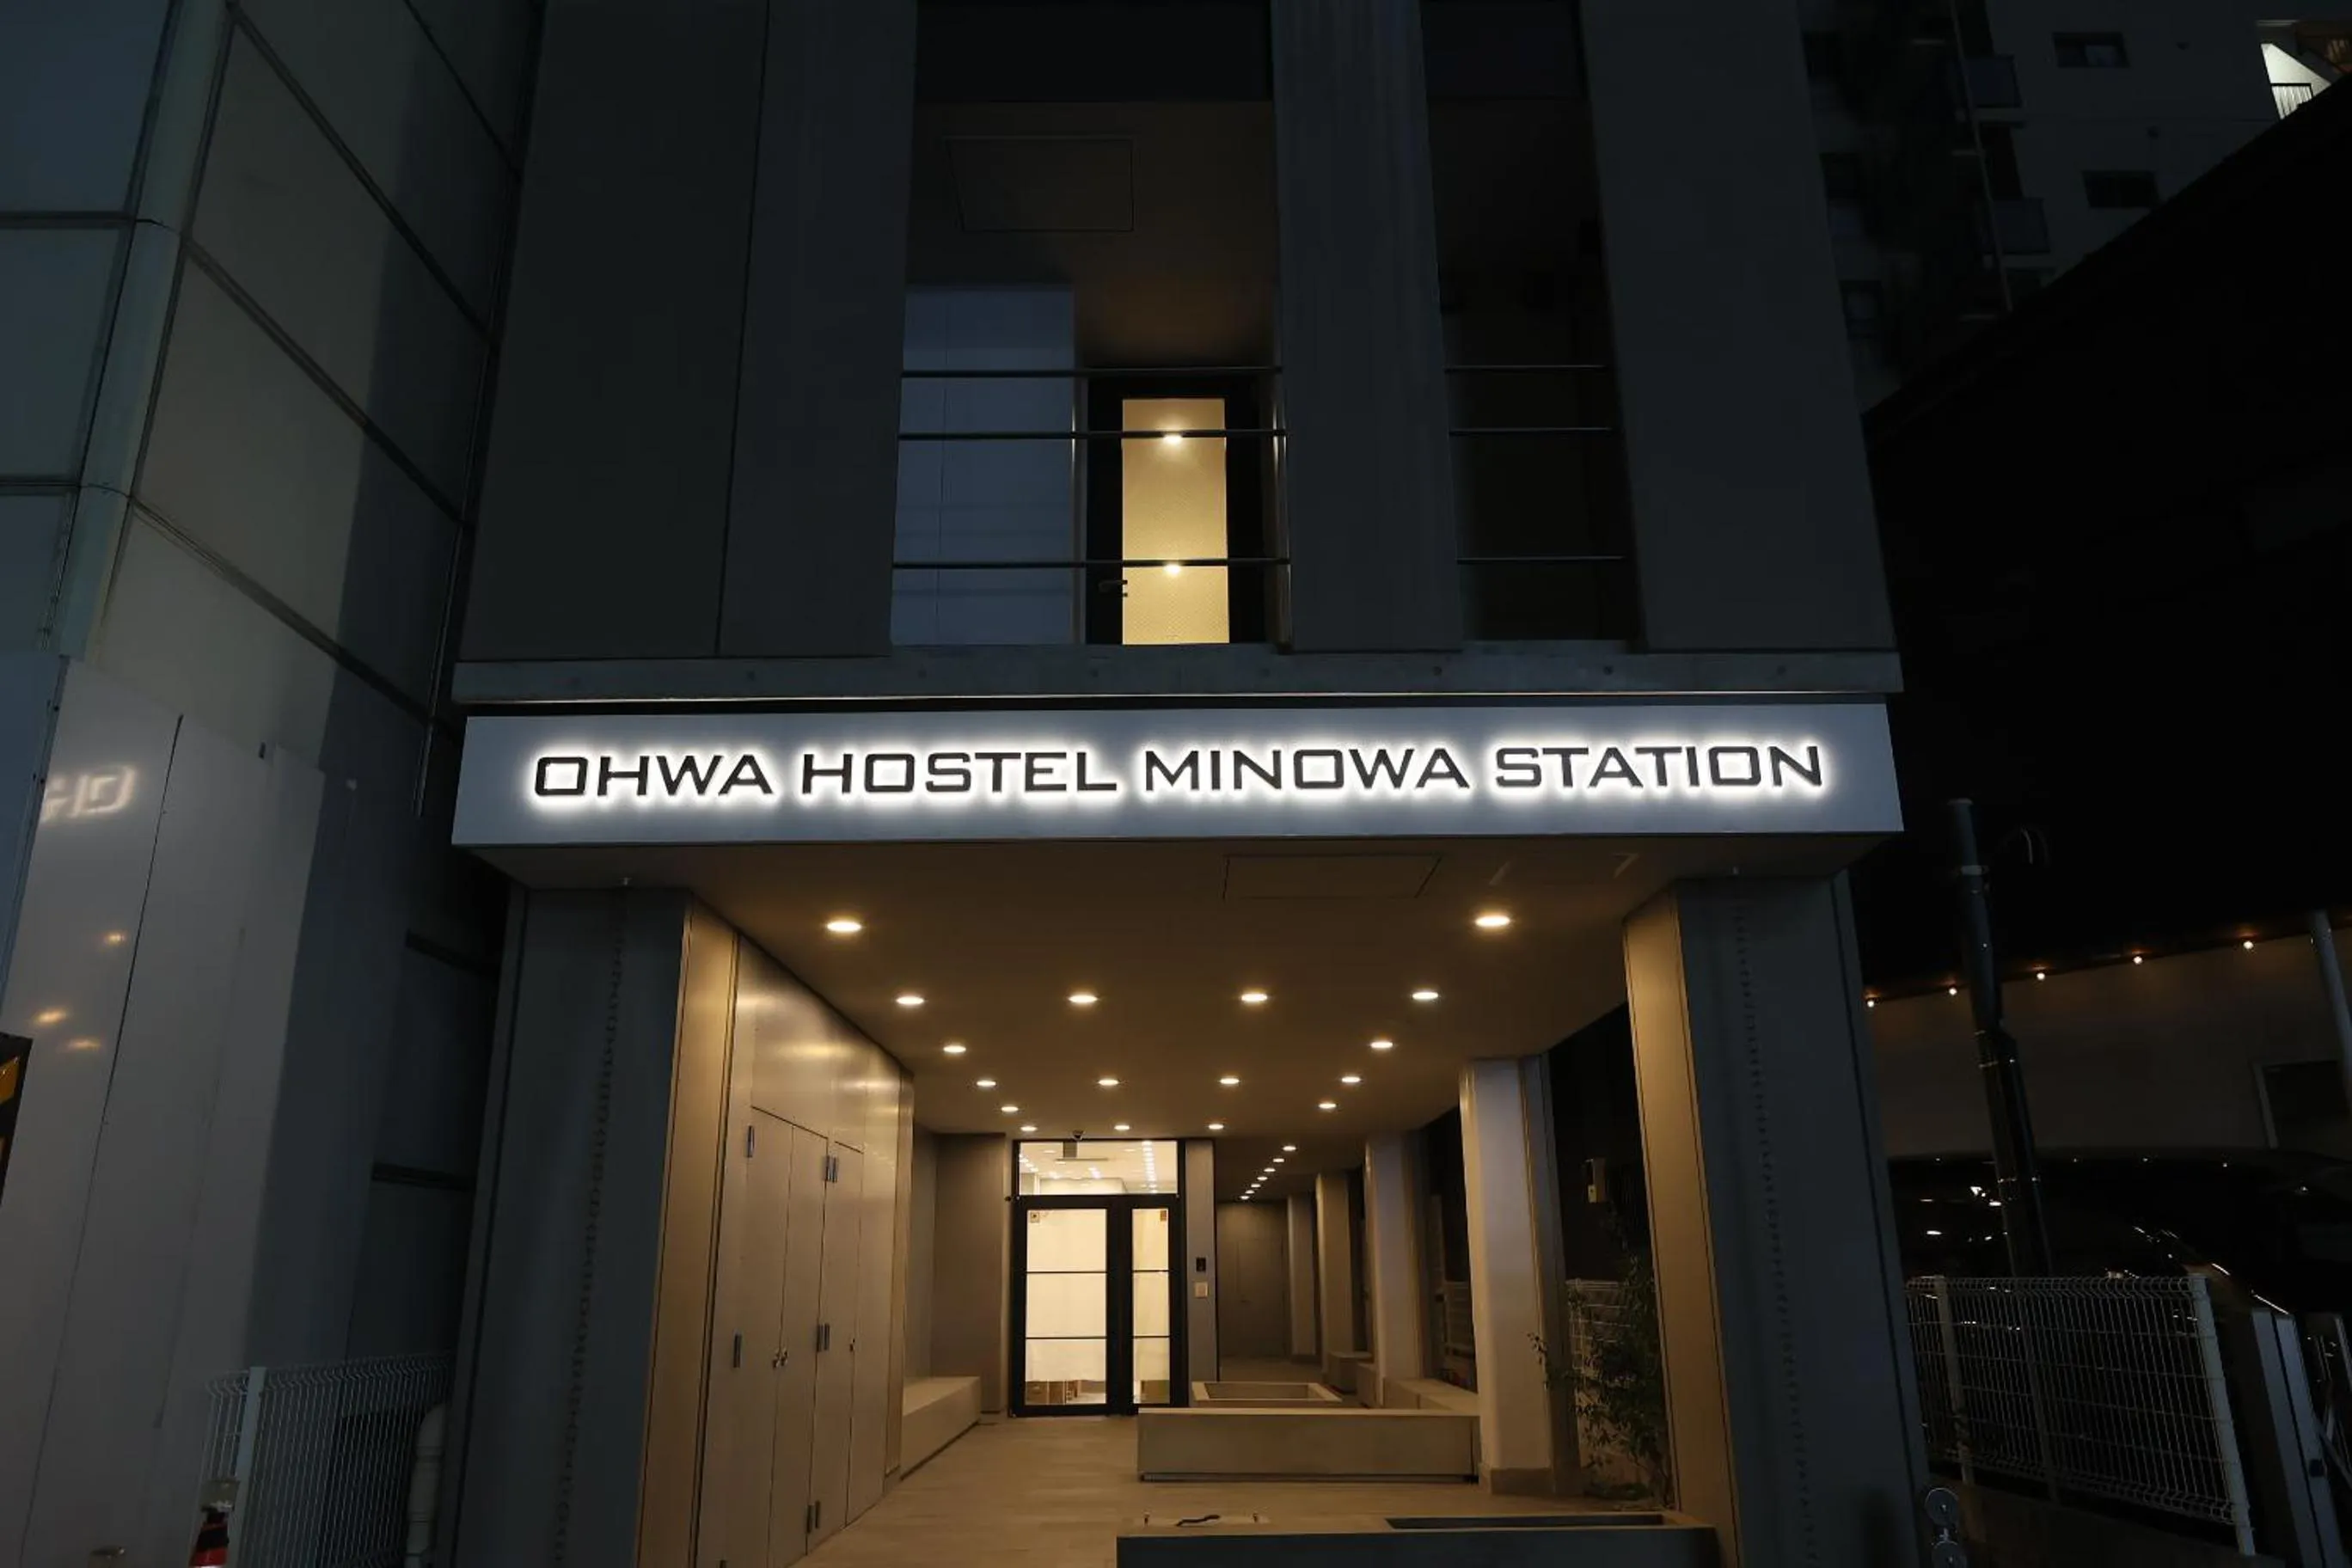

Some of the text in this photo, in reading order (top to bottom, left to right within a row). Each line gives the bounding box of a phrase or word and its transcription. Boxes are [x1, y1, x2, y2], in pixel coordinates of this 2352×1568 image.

[535, 745, 1822, 796] OHWA HOSTEL MINOWA STATION
